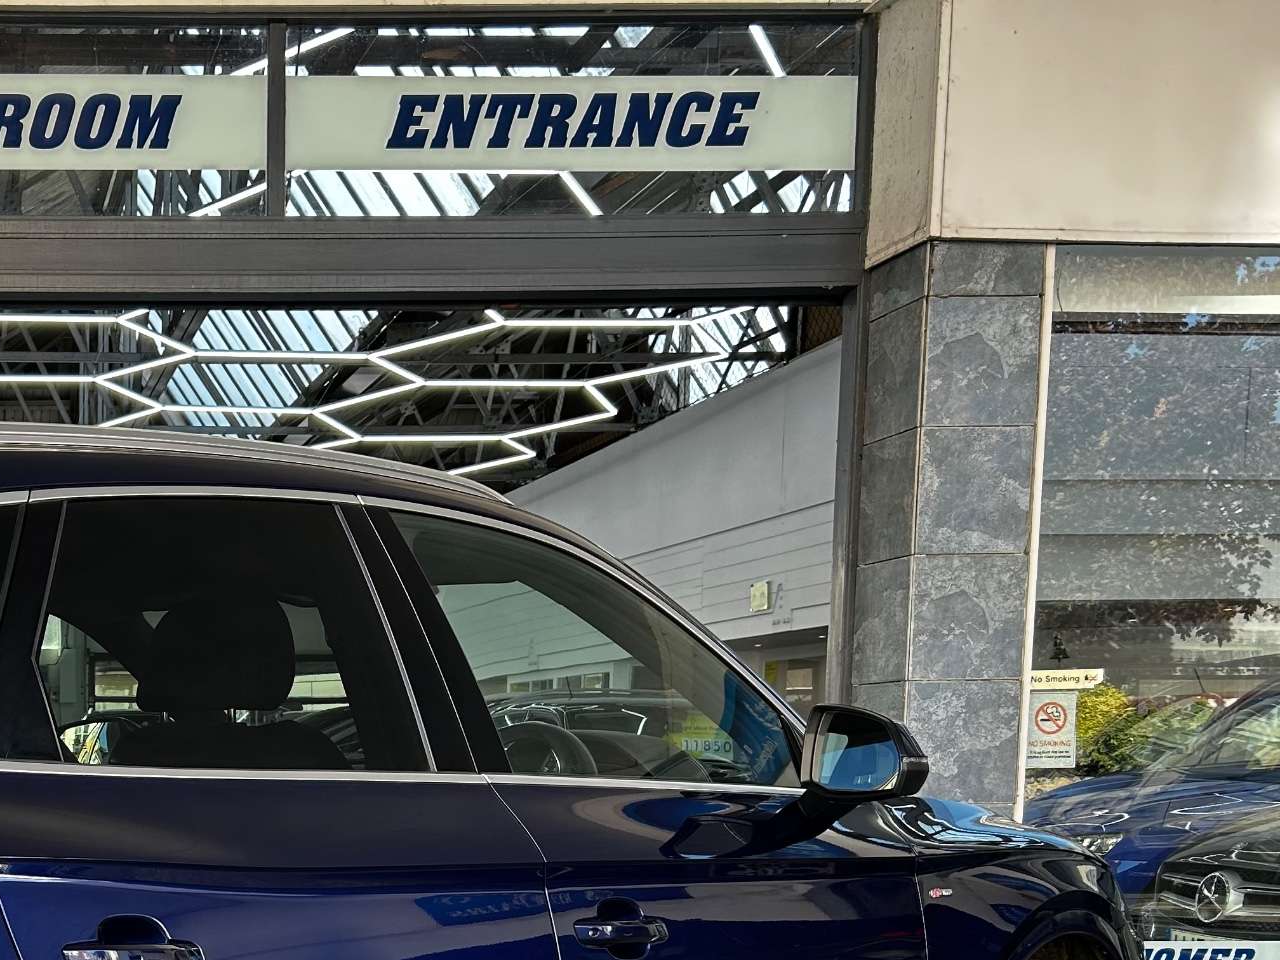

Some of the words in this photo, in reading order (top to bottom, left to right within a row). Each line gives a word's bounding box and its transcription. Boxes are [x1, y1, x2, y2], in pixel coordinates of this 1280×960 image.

[386, 90, 761, 150] ENTRANCE
[1030, 675, 1043, 683] No
[1045, 674, 1080, 684] Smoking
